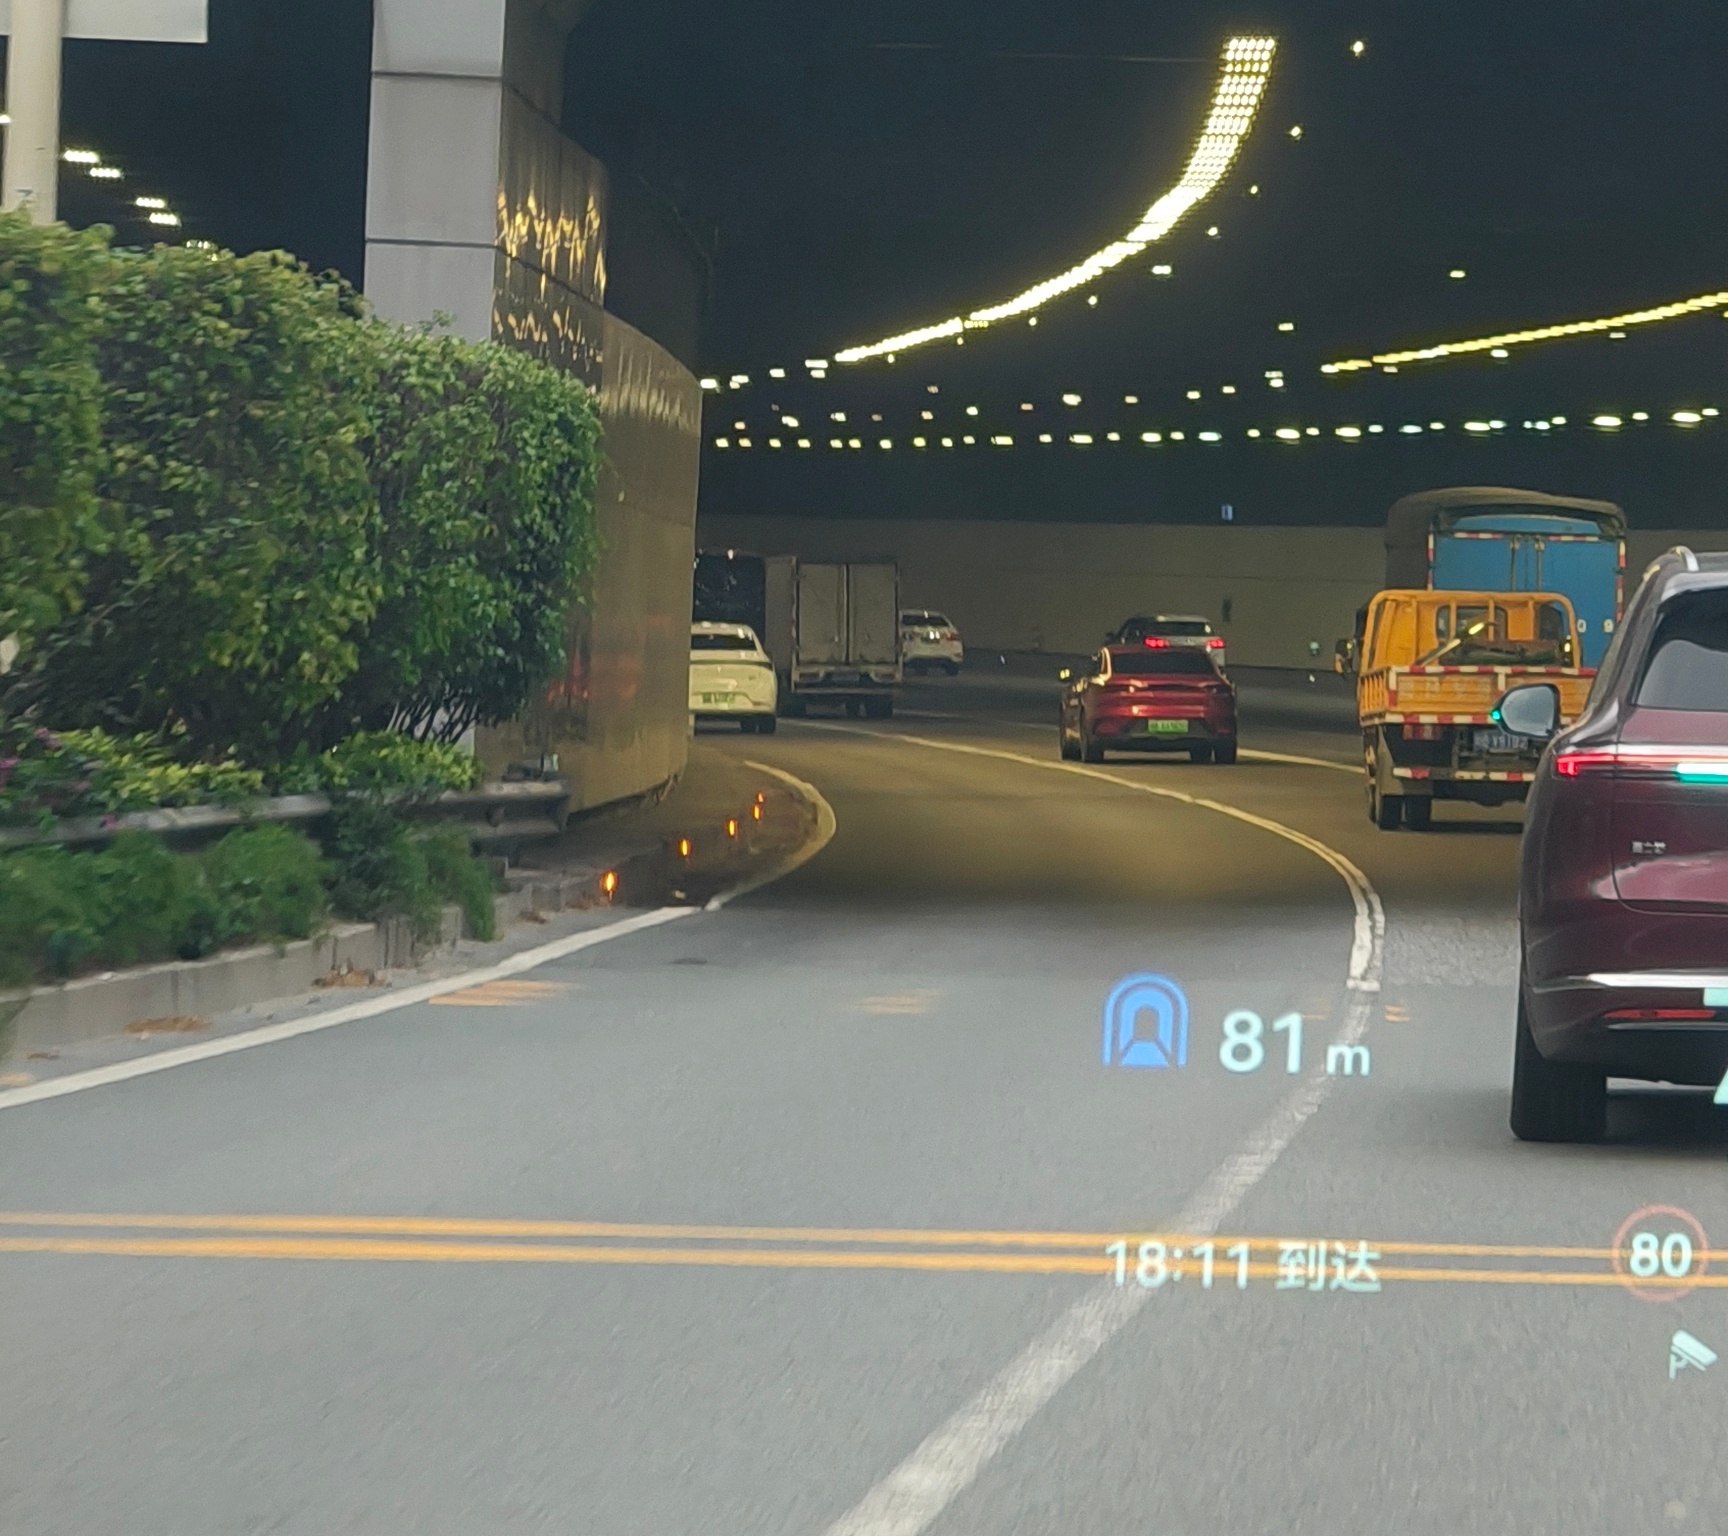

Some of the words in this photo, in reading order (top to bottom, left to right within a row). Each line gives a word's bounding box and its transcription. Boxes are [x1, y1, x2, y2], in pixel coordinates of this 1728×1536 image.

[1219, 1009, 1304, 1073] 81
[1105, 1240, 1250, 1289] 18:11
[1275, 1240, 1382, 1292] 到达
[1629, 1232, 1693, 1278] 80
